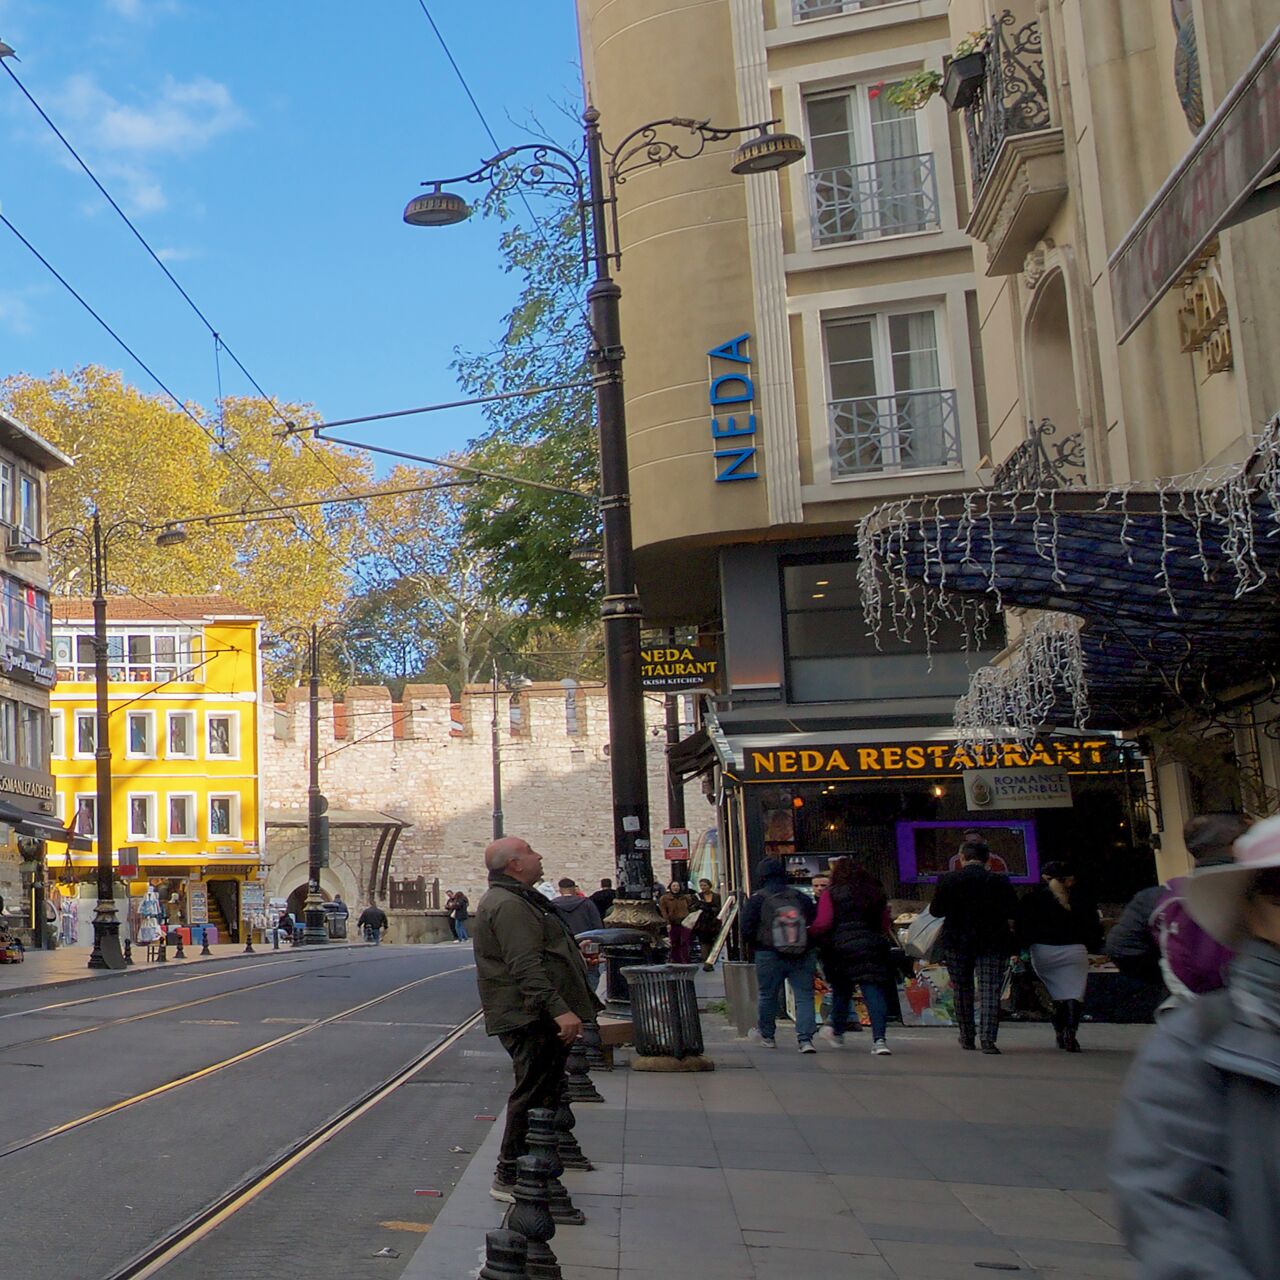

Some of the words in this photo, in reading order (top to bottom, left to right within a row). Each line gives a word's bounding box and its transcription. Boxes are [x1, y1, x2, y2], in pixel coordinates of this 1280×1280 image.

[706, 331, 760, 482] NEDA
[641, 648, 694, 662] NEDA
[641, 661, 718, 677] TAURANT
[667, 677, 704, 685] KITCHEN
[752, 750, 850, 773] NEDA
[857, 740, 1108, 771] RESTAURANT
[994, 774, 1064, 785] ROMANCE
